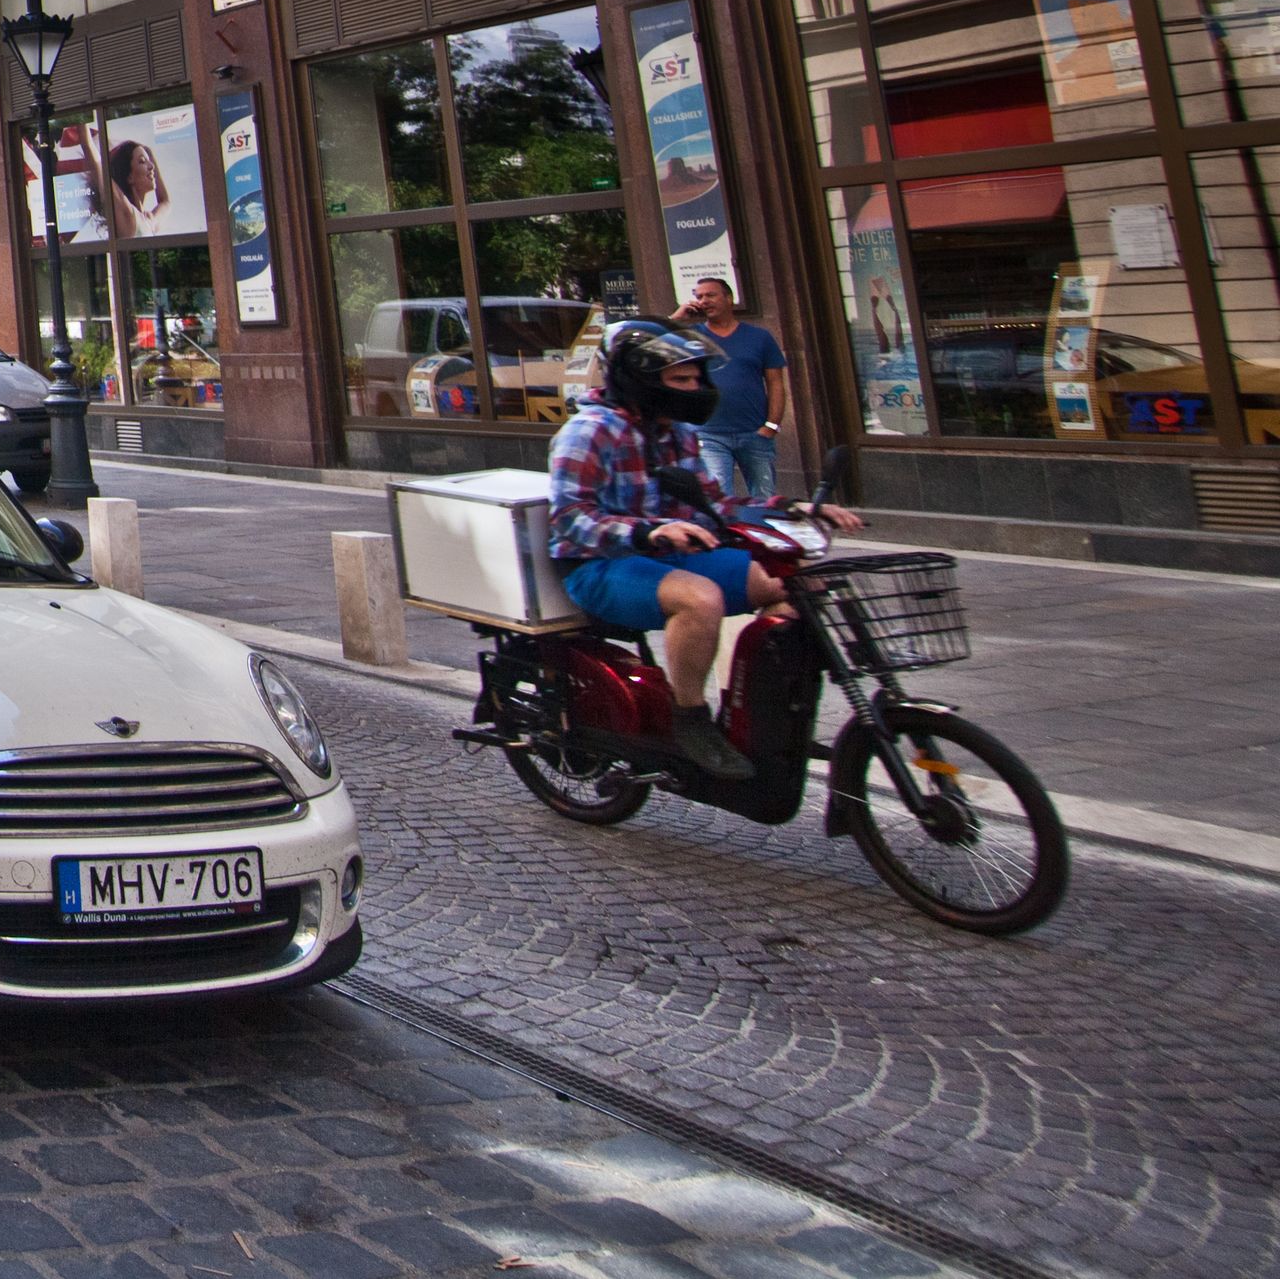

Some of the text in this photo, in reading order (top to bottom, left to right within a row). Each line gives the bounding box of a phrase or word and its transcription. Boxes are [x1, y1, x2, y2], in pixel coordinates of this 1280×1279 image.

[651, 56, 691, 81] AST
[653, 109, 704, 125] SZÁLLÁSHELY
[227, 133, 252, 150] AST
[676, 215, 717, 230] FOGLALÁS
[1127, 398, 1204, 426] AST
[89, 856, 253, 907] MHV-706
[64, 889, 76, 906] H
[73, 912, 101, 923] Wallis
[103, 912, 127, 922] Duna
